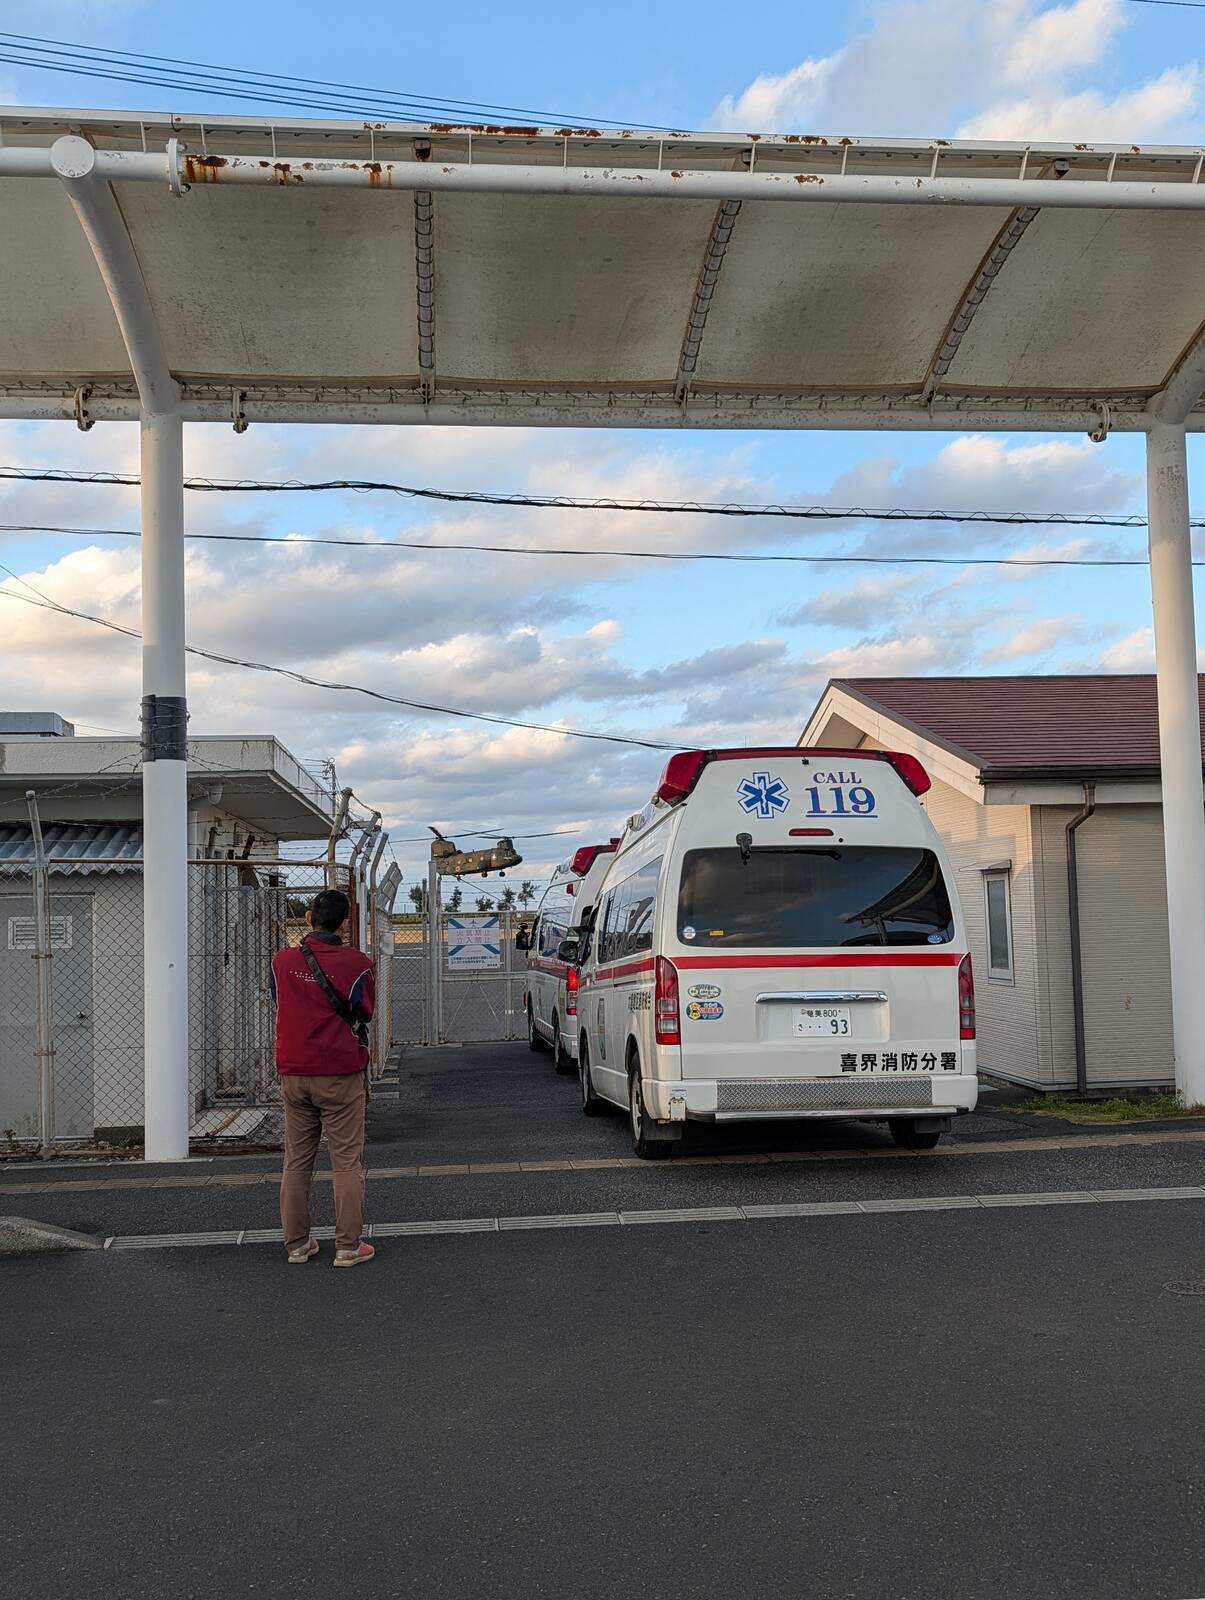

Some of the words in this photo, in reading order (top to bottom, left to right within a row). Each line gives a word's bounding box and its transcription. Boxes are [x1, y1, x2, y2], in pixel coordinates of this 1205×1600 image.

[813, 771, 862, 784] CALL
[804, 786, 876, 814] 119
[840, 1052, 957, 1073] 喜界消防分署
